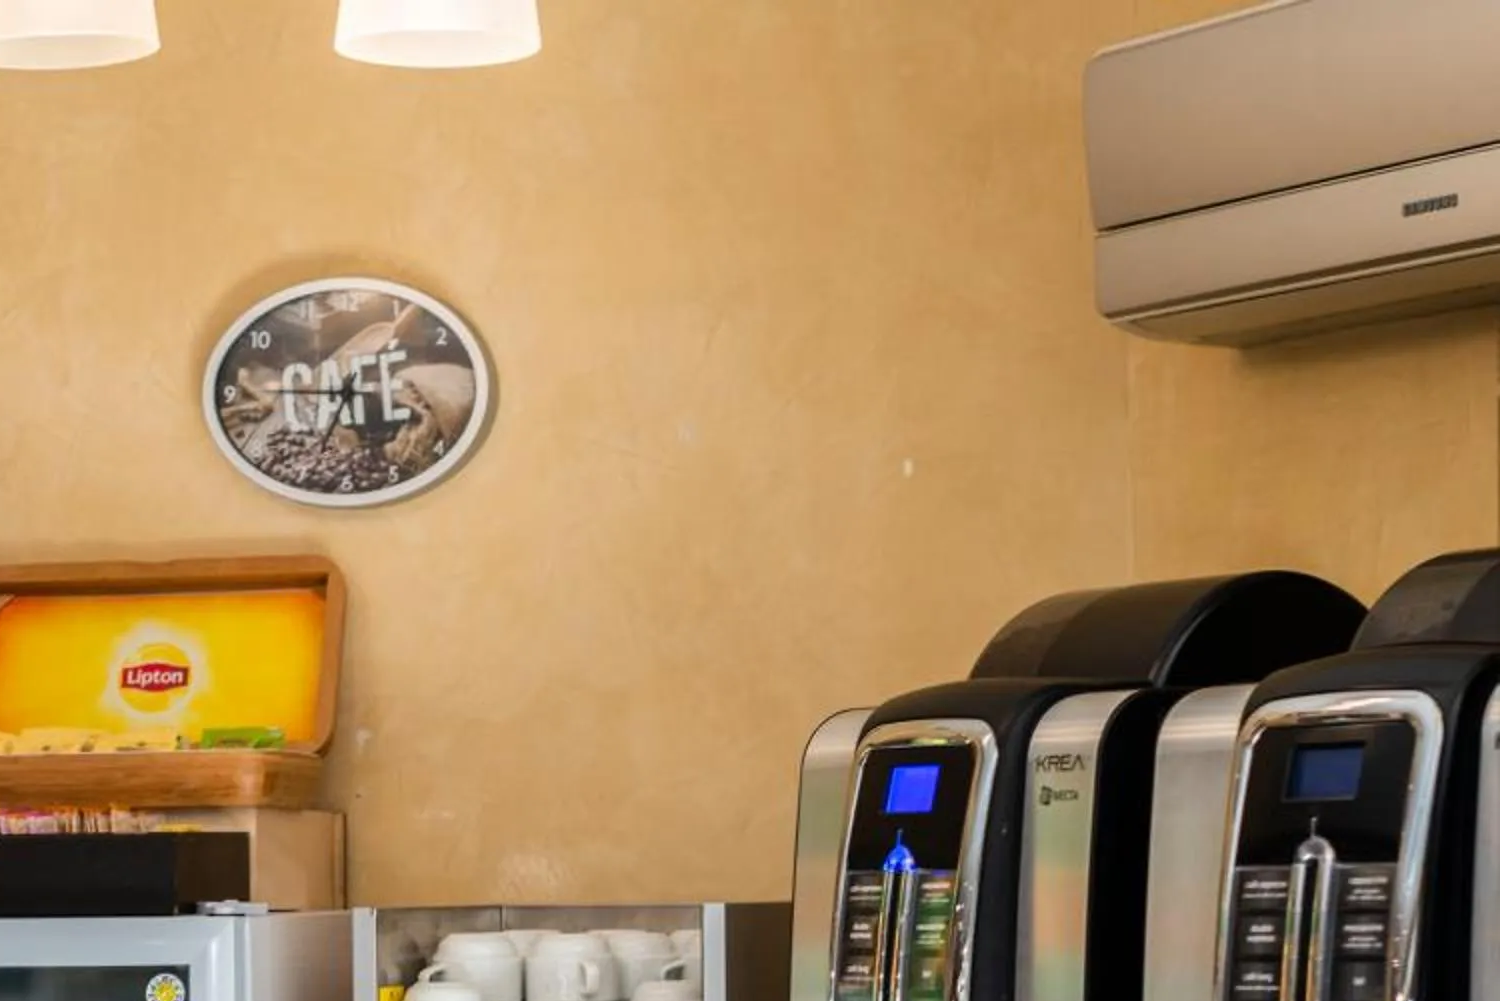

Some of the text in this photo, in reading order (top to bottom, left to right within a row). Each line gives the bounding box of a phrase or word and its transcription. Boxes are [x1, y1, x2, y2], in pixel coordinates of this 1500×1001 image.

[250, 331, 272, 349] 10
[435, 327, 449, 346] 2
[281, 337, 412, 432] CAFÉ
[223, 385, 237, 404] 9
[126, 668, 184, 689] Lipton
